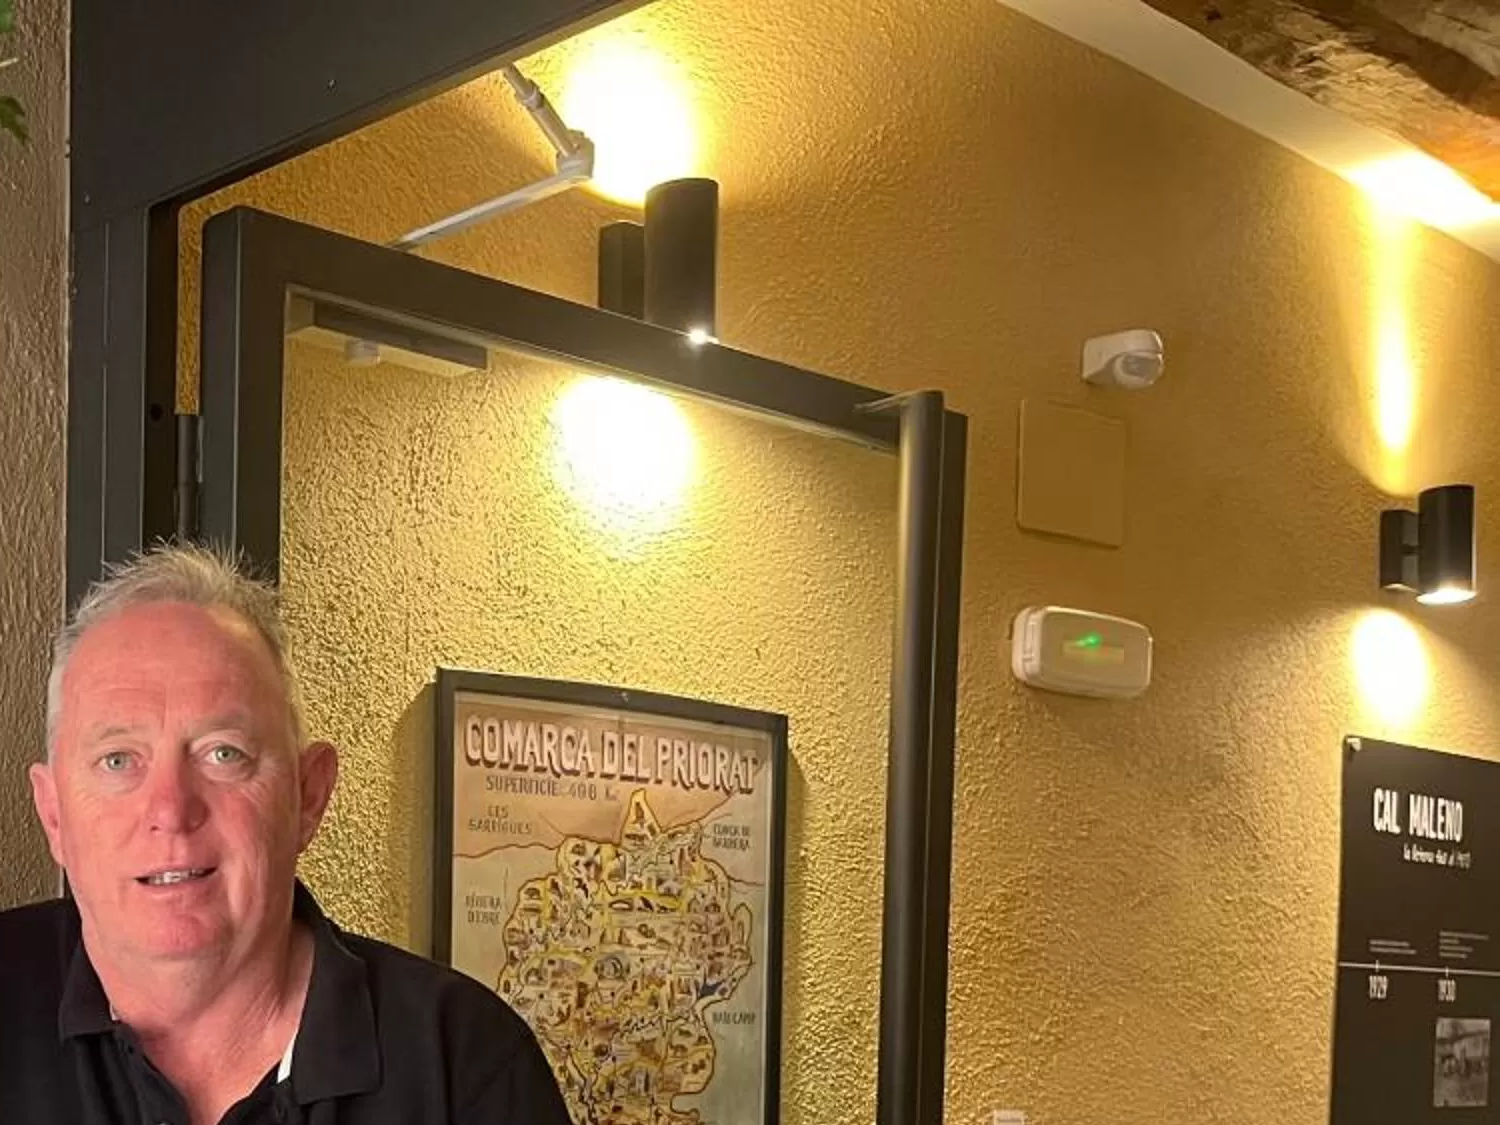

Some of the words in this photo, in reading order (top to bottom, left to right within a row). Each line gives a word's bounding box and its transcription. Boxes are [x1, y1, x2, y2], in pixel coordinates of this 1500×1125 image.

[464, 715, 595, 779] COMARCA
[600, 731, 650, 782] DEL
[654, 736, 758, 794] PRIORAT
[1373, 787, 1401, 834] CAL
